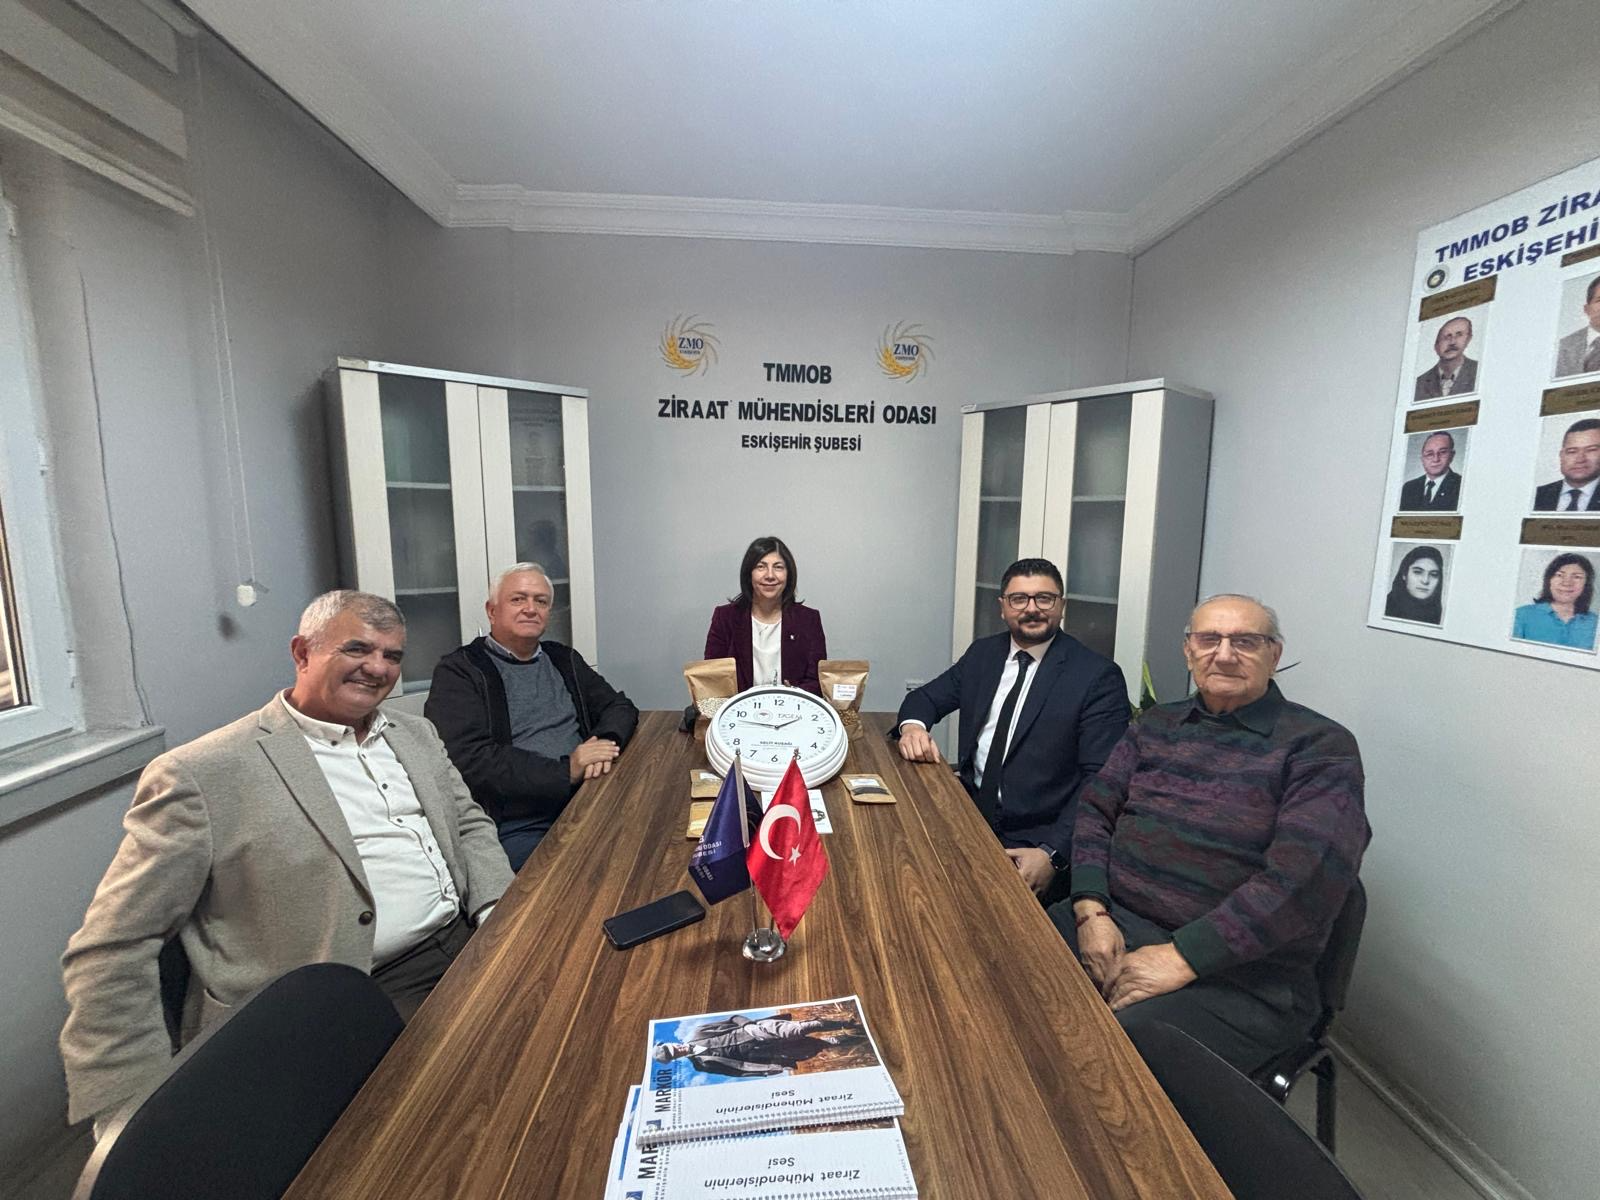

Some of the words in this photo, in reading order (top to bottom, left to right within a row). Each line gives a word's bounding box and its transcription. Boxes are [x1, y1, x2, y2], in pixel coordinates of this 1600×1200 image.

[1436, 216, 1529, 263] TMMOB
[678, 337, 704, 350] ZMO
[894, 343, 919, 356] ZMO
[763, 362, 832, 384] TMMOB
[658, 394, 729, 419] ZİRAAT
[738, 397, 874, 423] MÜHENDİSLERİ
[882, 405, 936, 424] ODASI
[741, 432, 811, 452] ESKİŞEHİR
[814, 434, 861, 453] ŞUBESİ
[750, 749, 757, 757] 7
[652, 1069, 672, 1113] MARKÖR
[771, 1090, 795, 1099] Sesi
[819, 1093, 854, 1103] Ziraat
[716, 1099, 813, 1114] Mühendislerinin
[768, 1157, 795, 1169] Sesi
[704, 1173, 814, 1190] Mühendislerinin
[821, 1169, 860, 1181] Ziraat
